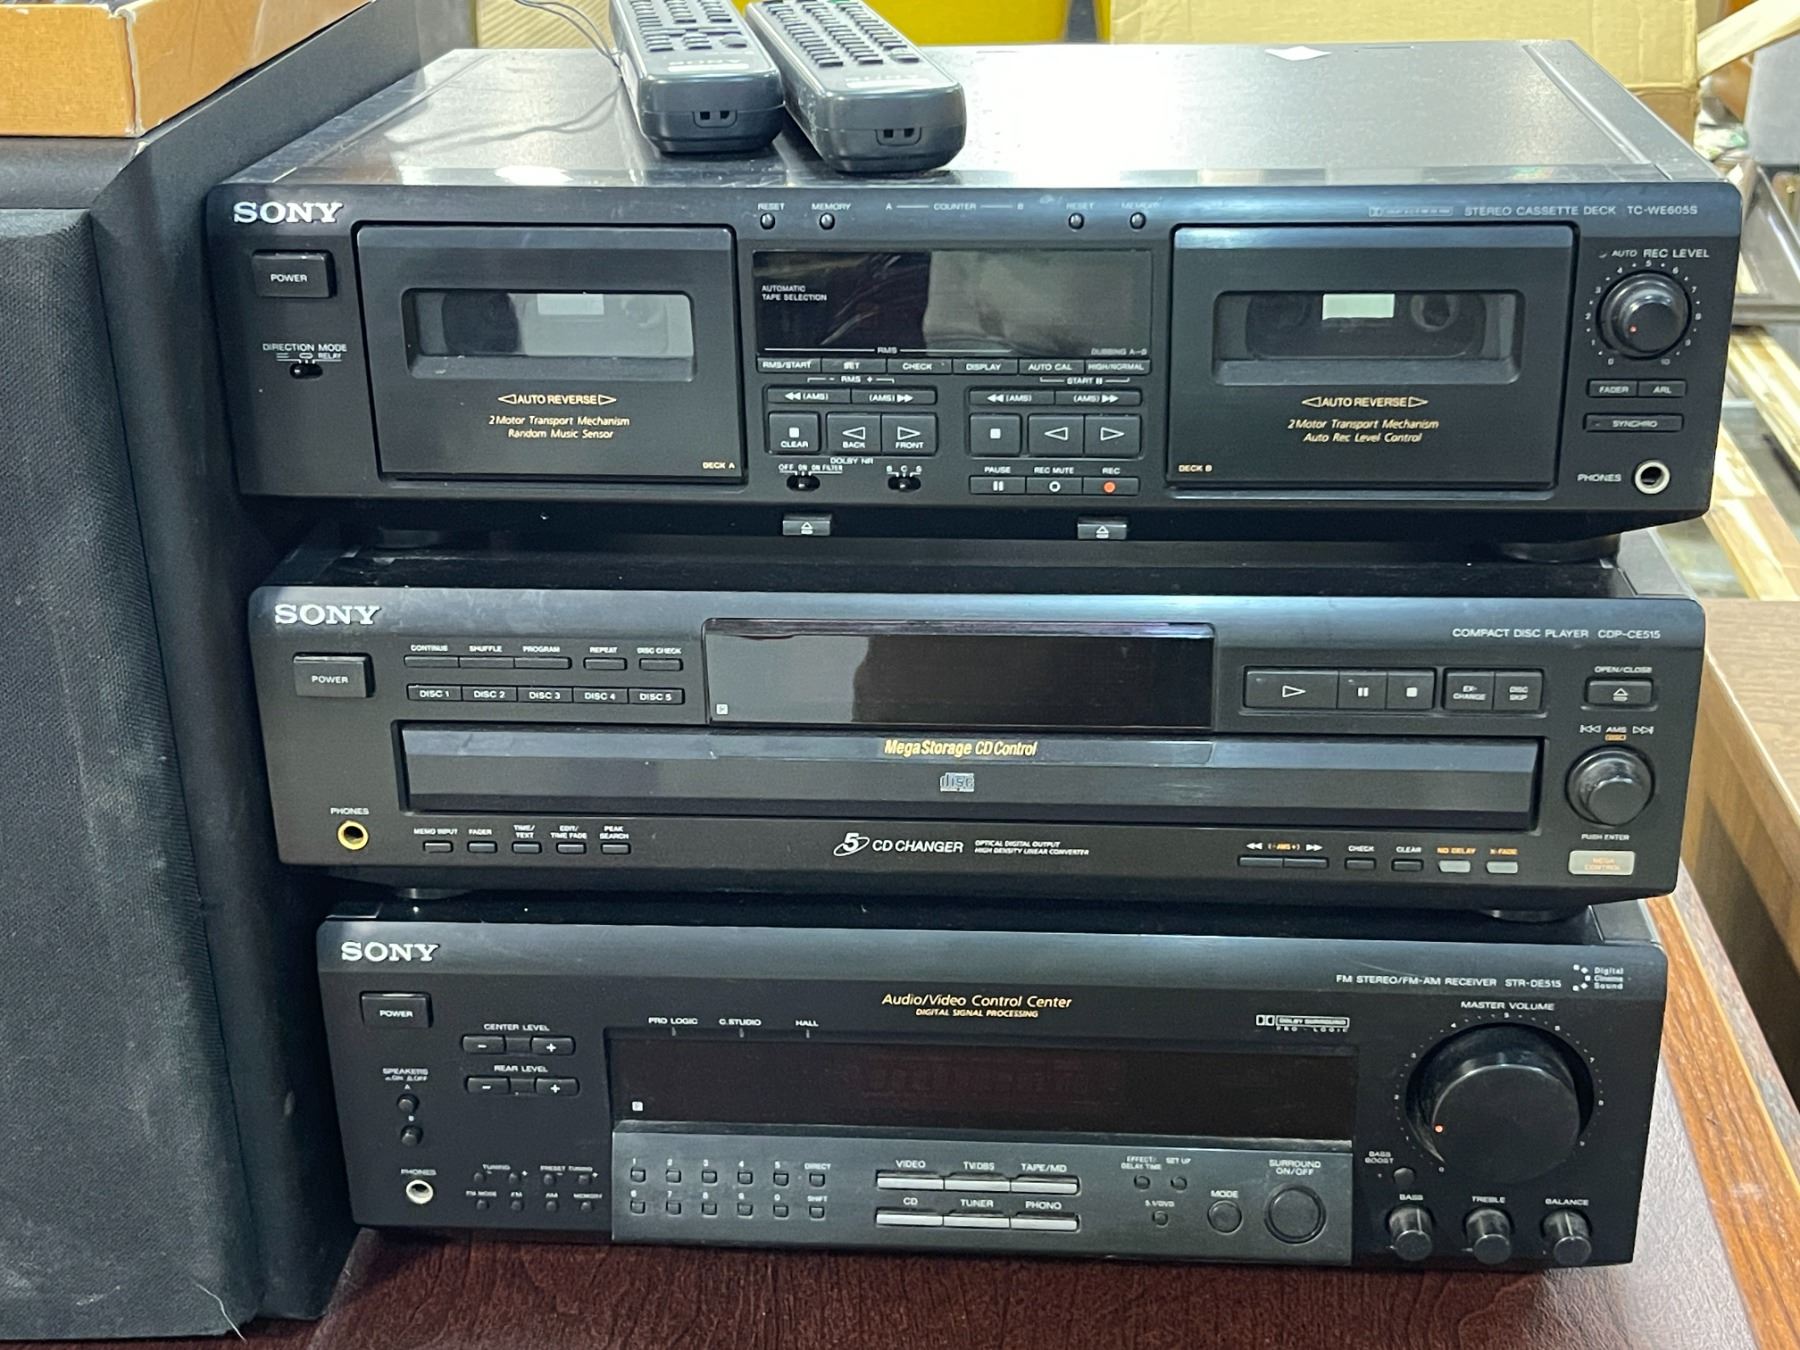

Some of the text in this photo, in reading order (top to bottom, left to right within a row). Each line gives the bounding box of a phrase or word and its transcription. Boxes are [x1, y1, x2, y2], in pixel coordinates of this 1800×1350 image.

[933, 203, 976, 211] COUNTER
[1465, 205, 1698, 216] STEREO CASSETTE DECK TC-WE605S
[233, 202, 343, 224] SONY
[1644, 249, 1668, 258] REC
[1672, 249, 1710, 258] LEVEL
[271, 274, 307, 282] POWER
[762, 285, 806, 293] AUTOMATIC
[784, 294, 827, 302] SELECTION
[263, 344, 347, 352] DIRECTION MODE
[966, 363, 1001, 371] DISPLAY
[1028, 363, 1072, 371] AUTO CAL
[517, 395, 597, 405] AUTO REVERSE
[1322, 397, 1407, 407] AUTO REVERSE
[529, 416, 573, 426] Transport
[577, 416, 630, 426] Mechanism
[1331, 419, 1378, 430] Transport
[1382, 419, 1439, 429] Mechanism
[508, 428, 613, 439] Random Music Sensor
[1303, 432, 1422, 442] Auto Rec Level Control
[842, 441, 865, 449] BACK
[895, 441, 924, 449] FRONT
[984, 466, 1011, 474] PAUSE
[1577, 474, 1622, 482] PHONES
[274, 604, 380, 625] SONY
[1452, 628, 1661, 639] COMPACT DISC PLAYER CDP-CE515
[1594, 666, 1652, 674] OPEN/CLOSE
[311, 676, 349, 684] POWER
[419, 690, 443, 698] DISC
[473, 690, 497, 698] DISC
[529, 691, 552, 699] DISC
[584, 692, 608, 700] DISC
[639, 693, 664, 701] DISC
[330, 807, 370, 815] PHONES
[872, 839, 893, 852] CD
[895, 840, 964, 853] CHANGER
[341, 942, 439, 962] SONY
[1594, 967, 1624, 975] Digital
[1336, 975, 1562, 988] FM STEREO/FM-AM RECEIVER STR-DE515
[881, 994, 1072, 1008] Audio/Video Control Center
[1461, 1001, 1555, 1011] MASTER VOLUME
[380, 1010, 413, 1018] POWER
[916, 1008, 1039, 1017] DIGITAL SIGNAL PROCESSING
[895, 1160, 926, 1168] VIDEO
[1021, 1163, 1067, 1172] TAPE/MD
[1269, 1159, 1321, 1168] SURROUND
[1276, 1167, 1314, 1175] ON/OFF
[903, 1198, 918, 1206] CD
[961, 1199, 993, 1207] TUNER
[1025, 1201, 1062, 1210] PHONO
[1545, 1198, 1589, 1206] BALANCE
